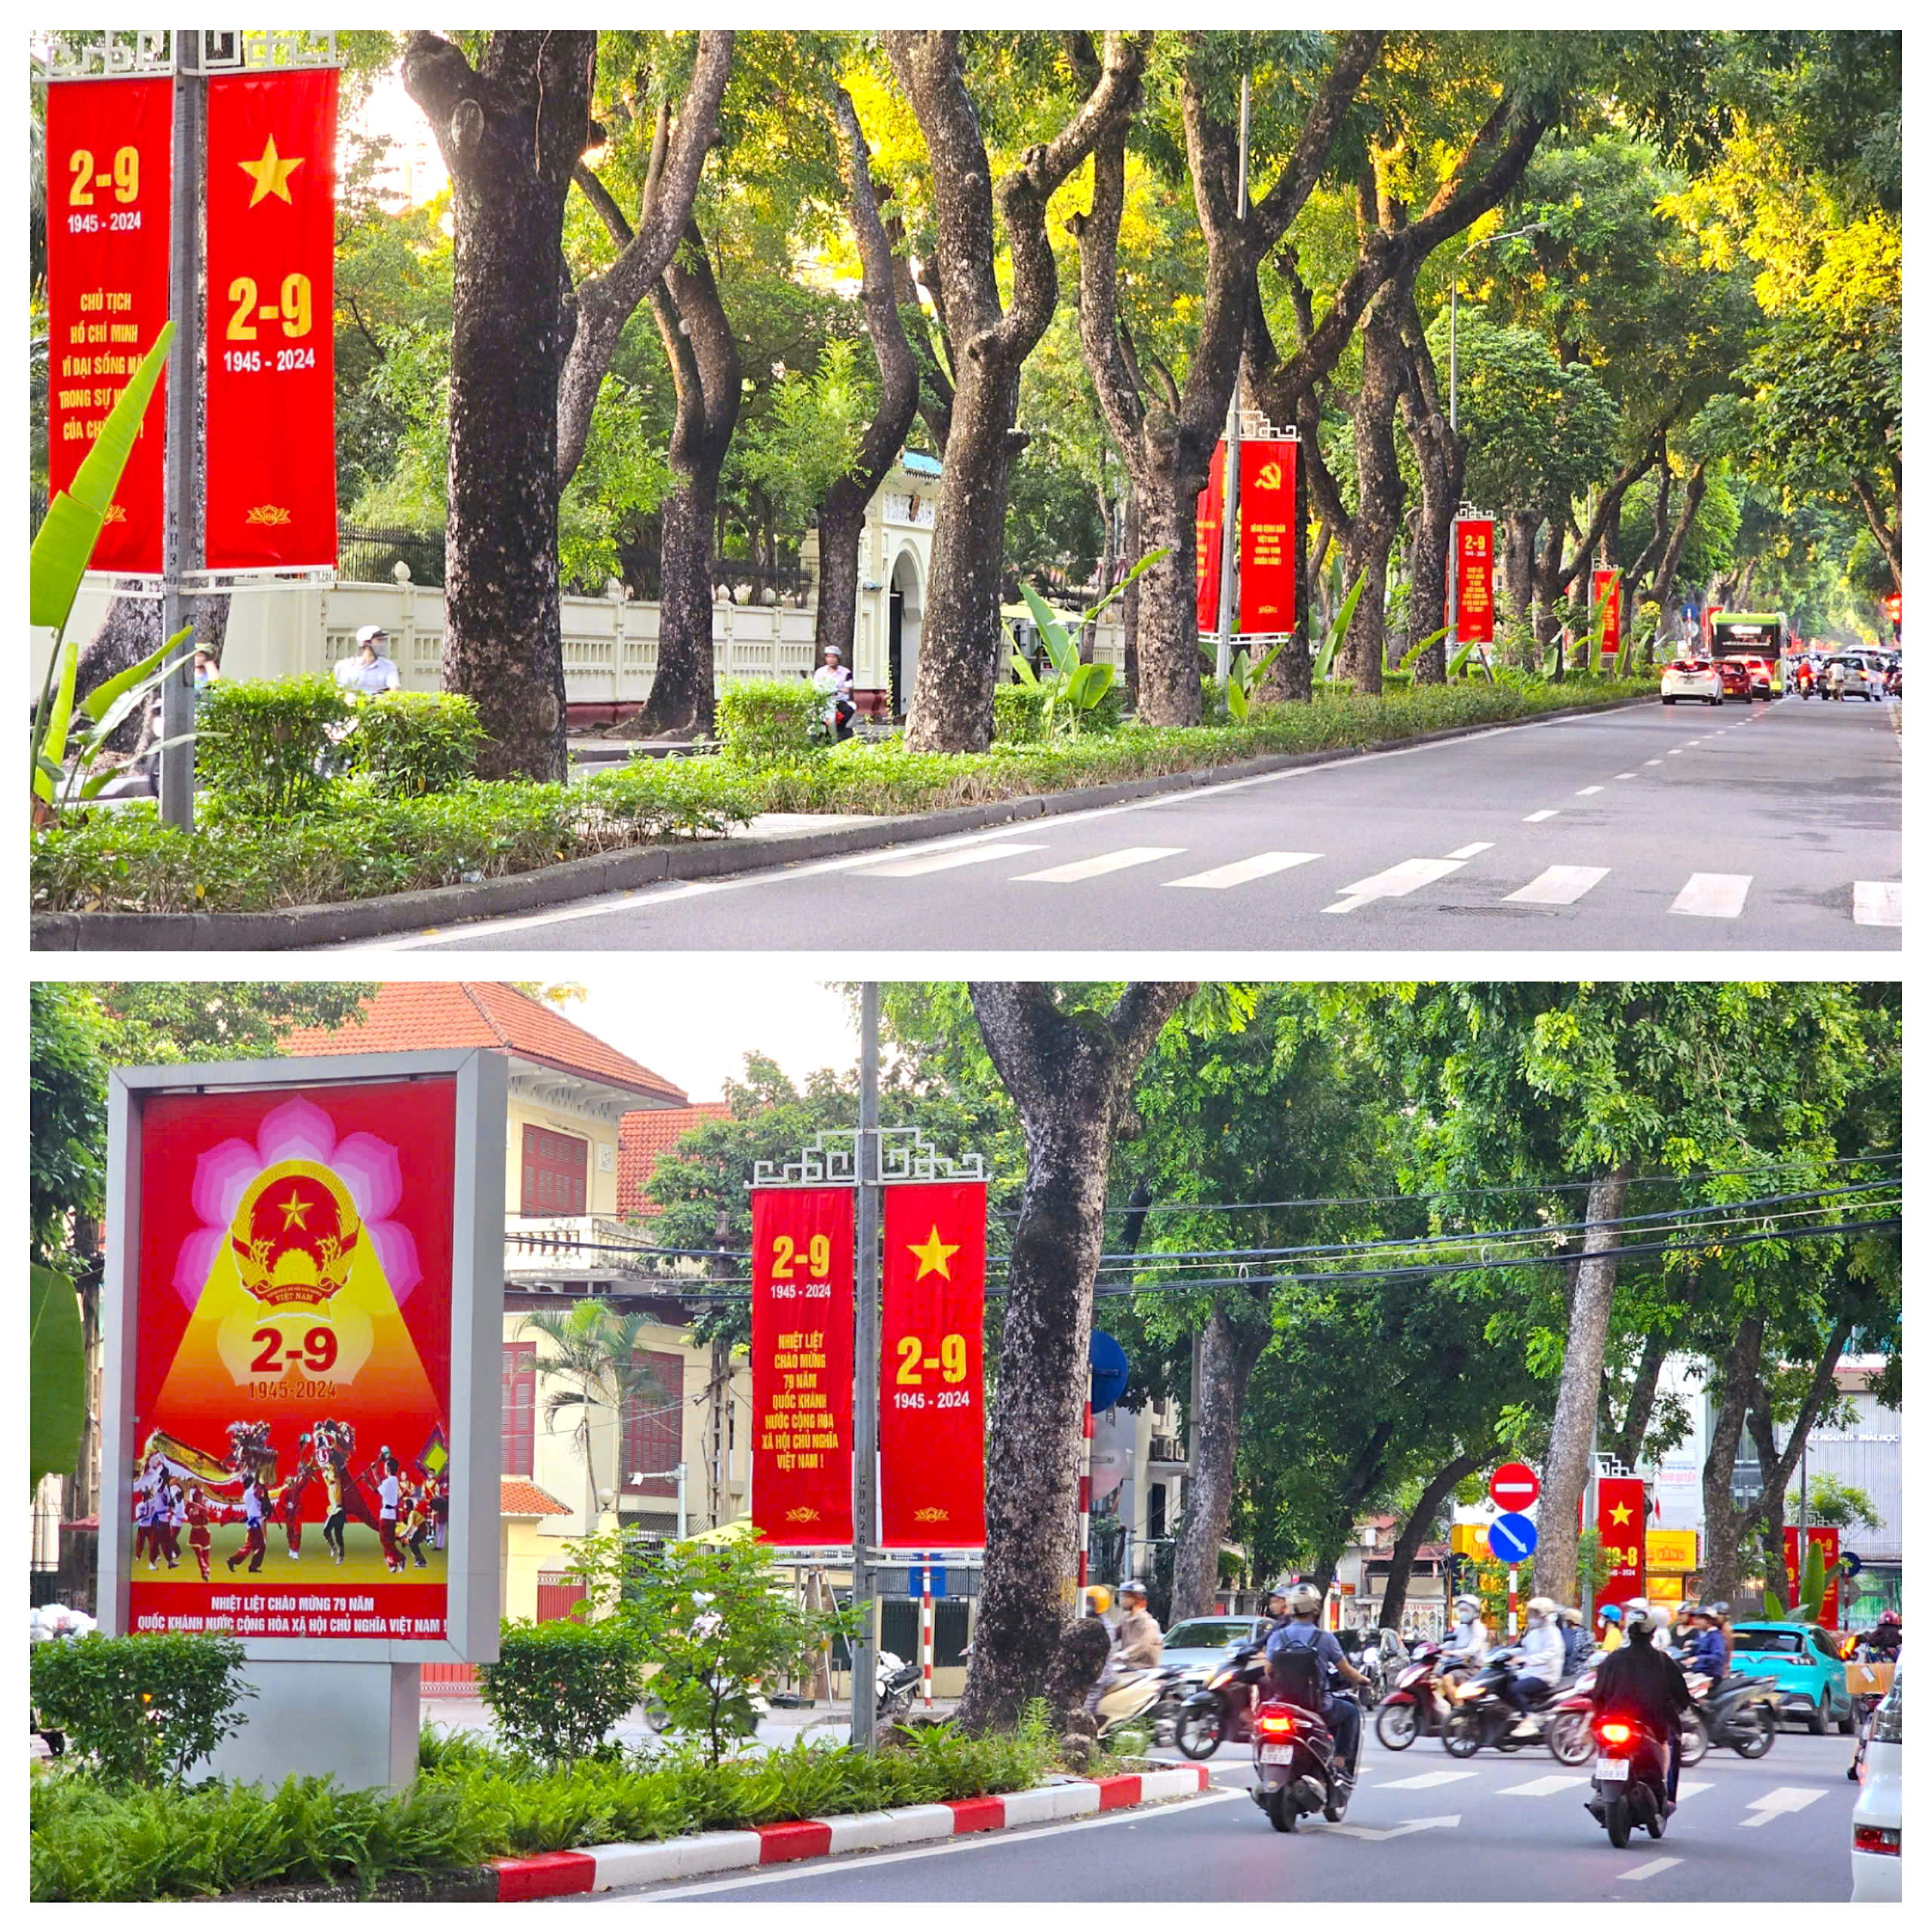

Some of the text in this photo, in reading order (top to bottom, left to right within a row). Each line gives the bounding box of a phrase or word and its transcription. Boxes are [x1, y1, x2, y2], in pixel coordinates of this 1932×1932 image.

[69, 146, 139, 205] 2-9
[68, 214, 98, 232] 1945
[110, 211, 141, 230] 2024
[81, 288, 131, 314] CHỦ TỊCH
[226, 273, 312, 340] 2-9
[88, 321, 106, 343] CHÍ
[111, 325, 138, 343] MINH
[73, 357, 91, 378] ĐẠI
[94, 351, 125, 374] SỐNG
[224, 351, 260, 372] 1945
[277, 348, 315, 371] 2024
[59, 389, 91, 409] TRONG
[94, 387, 112, 409] SỰ
[63, 417, 83, 440] CỦA
[1465, 535, 1485, 550] 2-9
[772, 1234, 829, 1278] 2-9
[771, 1284, 795, 1298] 1945
[806, 1284, 831, 1297] 2024
[251, 1327, 338, 1372] 2-9
[779, 1331, 823, 1352] NHIỆT LIỆT
[774, 1349, 826, 1369] CHÀO MỪNG
[897, 1334, 966, 1384] 2-9
[248, 1380, 337, 1399] 1945-2024
[783, 1371, 817, 1389] 79 NĂM
[773, 1389, 826, 1411] QUỐC KHÁNH
[894, 1393, 924, 1408] 1945
[937, 1391, 970, 1408] 2024
[792, 1411, 815, 1432] CỘNG
[817, 1411, 833, 1429] HÒA
[762, 1429, 838, 1452] XÃ HỘI CHỦ NGHĨA
[777, 1451, 795, 1472] VIỆT
[798, 1454, 818, 1469] NAM
[211, 1595, 374, 1613] NHIỆT LIỆT CHÀO MỪNG 79 NĂM
[138, 1612, 165, 1630] QUỐC
[168, 1614, 203, 1632] KHÁNH
[205, 1614, 234, 1632] NƯỚC
[237, 1615, 265, 1634] CỘNG
[268, 1615, 289, 1632] HÒA
[309, 1616, 327, 1635] HỘI
[330, 1614, 351, 1632] CHỦ
[354, 1617, 386, 1632] NGHĨA
[389, 1616, 412, 1635] VIỆT
[415, 1619, 440, 1632] NAM
